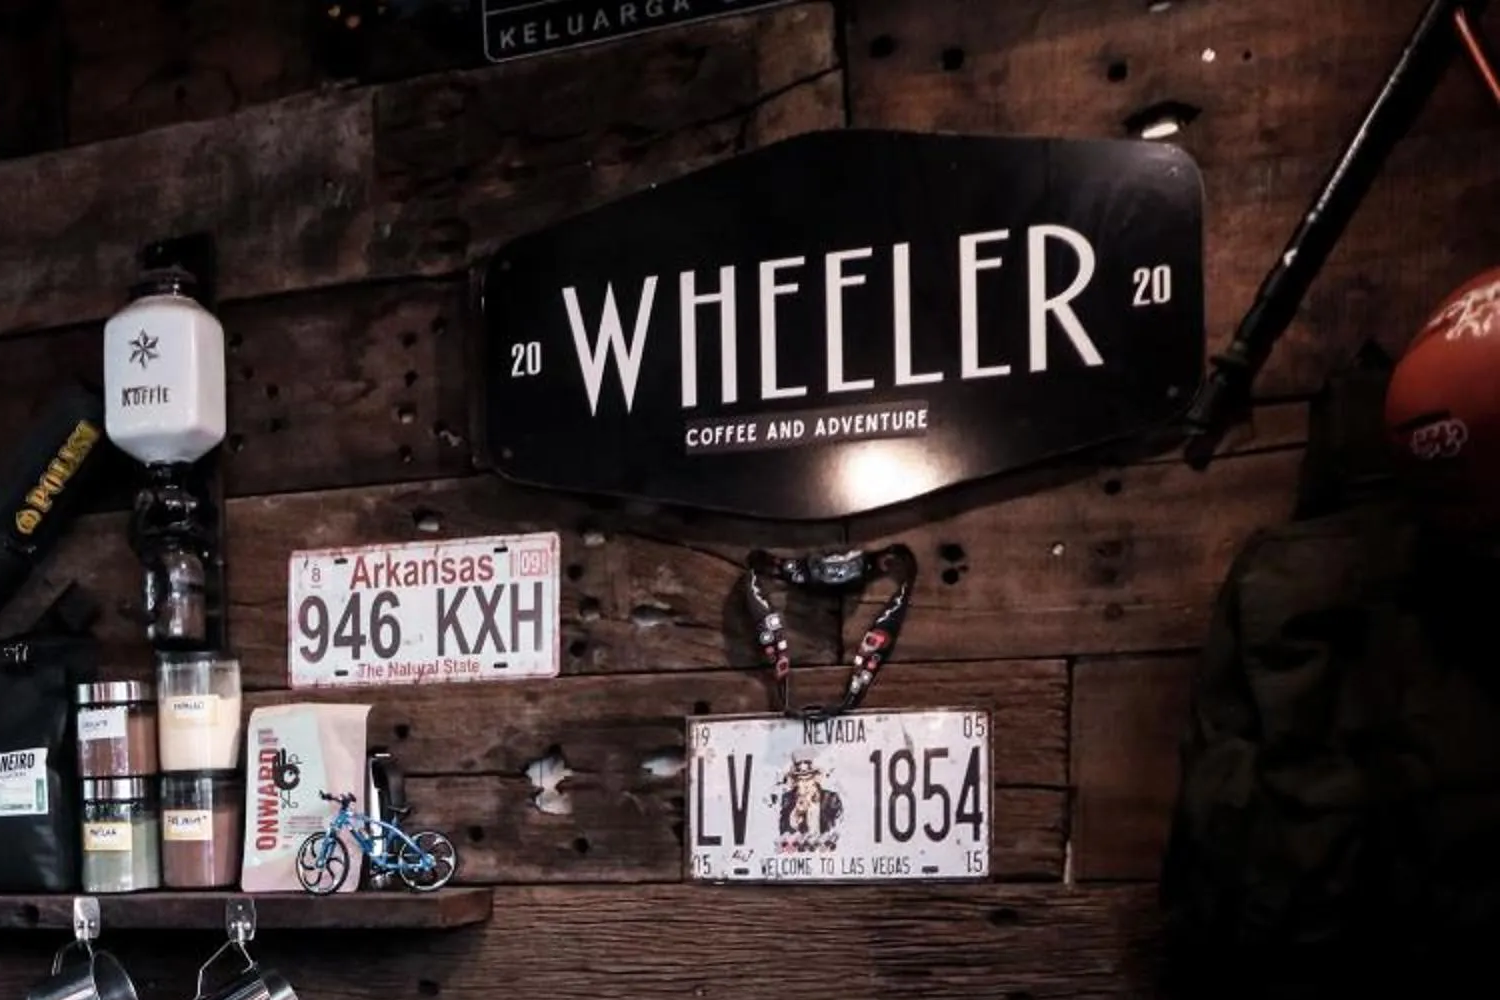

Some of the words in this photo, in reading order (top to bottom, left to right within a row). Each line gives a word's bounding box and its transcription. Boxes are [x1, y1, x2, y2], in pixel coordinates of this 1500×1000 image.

[1132, 264, 1172, 307] 20
[561, 222, 1104, 418] WHEELER
[510, 341, 542, 378] 20
[686, 423, 757, 447] COFFEE
[766, 419, 805, 441] AND
[815, 409, 929, 437] ADVENTURE
[350, 552, 495, 590] Arkansas
[298, 590, 401, 663] 946
[436, 581, 544, 657] KXH
[357, 662, 383, 678] The
[388, 659, 439, 678] Natural
[443, 658, 480, 674] State
[802, 717, 867, 745] NEVADA
[962, 715, 985, 739] 05
[696, 754, 753, 846] LV
[868, 745, 983, 844] 1854
[760, 857, 813, 876] WELCOME
[819, 857, 835, 874] TO
[841, 857, 865, 875] LAS
[871, 856, 911, 874] VEGAS
